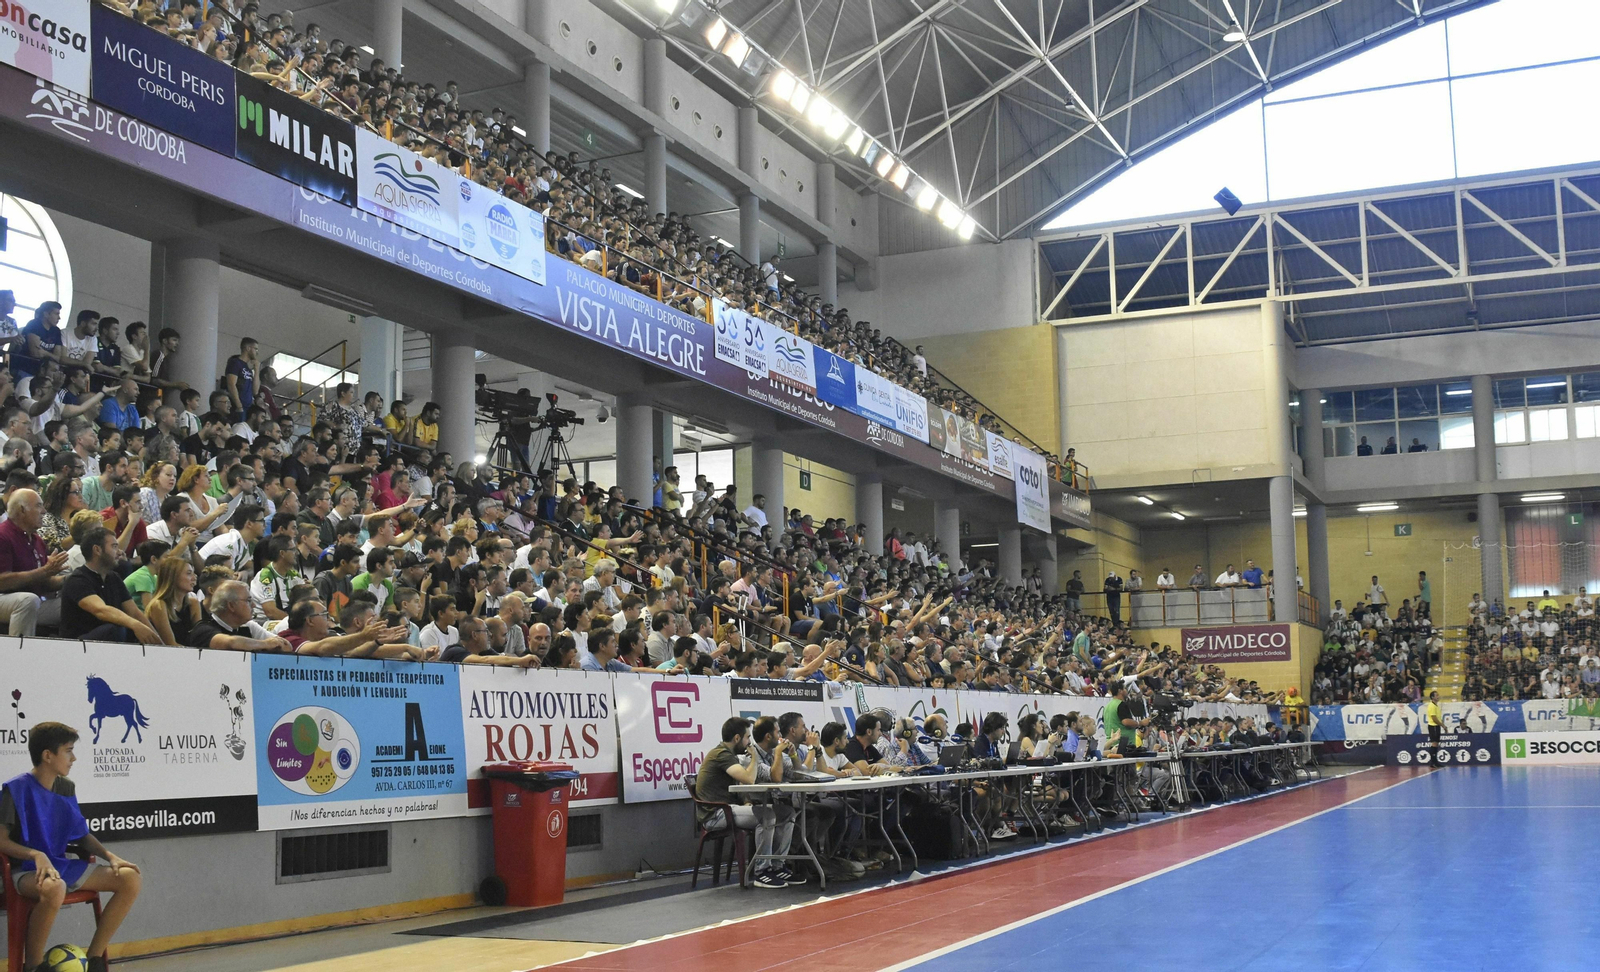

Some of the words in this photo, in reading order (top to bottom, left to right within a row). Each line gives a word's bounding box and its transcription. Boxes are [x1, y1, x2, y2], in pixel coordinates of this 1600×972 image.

[104, 36, 176, 84] MIGUEL
[181, 70, 224, 105] PERIS
[138, 78, 196, 112] CORDOBA
[95, 106, 114, 135] DE
[268, 108, 354, 178] MILAR
[586, 134, 592, 145] 4
[492, 209, 514, 227] RADIO
[300, 209, 343, 237] Instituto
[346, 228, 394, 258] Municipal
[398, 249, 410, 263] de
[412, 254, 454, 280] Deportes
[456, 272, 492, 295] Córdoba
[780, 246, 784, 256] 5
[566, 269, 606, 297] PALACIO
[608, 288, 655, 318] MUNICIPAL
[658, 308, 696, 335] DEPORTES
[556, 285, 620, 344] VISTA
[628, 317, 706, 376] ALEGRE
[718, 344, 736, 359] EMACSA
[745, 355, 762, 370] EMACSA
[748, 386, 768, 401] Instituto
[768, 394, 790, 410] Municipal
[896, 404, 924, 430] UNIFIS
[804, 474, 808, 486] D
[1571, 516, 1578, 524] L
[1398, 526, 1406, 534] K
[1208, 632, 1286, 650] IMDECO
[268, 668, 334, 682] ESPECIALISTAS
[338, 670, 346, 682] EN
[350, 670, 394, 684] PEDAGOGÍA
[396, 672, 444, 685] TERAPÉUTICA
[313, 686, 318, 696] Y
[321, 684, 361, 698] AUDICIÓN
[364, 687, 369, 698] Y
[371, 687, 408, 698] LENGUAJE
[777, 686, 797, 696] CÓRDOBA
[469, 690, 608, 719] AUTOMOVILES
[0, 730, 16, 744] TA
[159, 736, 174, 750] LA
[177, 735, 216, 749] VIUDA
[276, 738, 288, 748] Sin
[483, 724, 599, 762] ROJAS
[94, 748, 104, 756] LA
[106, 748, 134, 756] POSADA
[376, 746, 404, 756] ACADEMI
[430, 744, 446, 754] EIONE
[94, 756, 109, 764] DEL
[110, 756, 146, 764] CABALLO
[164, 752, 218, 764] TABERNA
[276, 758, 302, 768] Límites
[94, 764, 130, 772] ANDALUZ
[372, 767, 383, 778] 957
[384, 766, 392, 777] 25
[394, 766, 402, 777] 29
[403, 766, 412, 776] 05
[417, 765, 428, 776] 648
[430, 764, 438, 775] 04
[440, 764, 446, 774] 13
[447, 764, 454, 774] 85
[632, 752, 704, 790] Especolc
[375, 782, 396, 792] AVDA.
[398, 780, 425, 790] CARLOS
[427, 780, 437, 790] III,
[446, 780, 453, 788] 67
[311, 807, 357, 820] diferencian
[360, 805, 386, 816] hechos
[388, 808, 392, 818] y
[394, 806, 403, 814] no
[404, 800, 439, 815] palabras!
